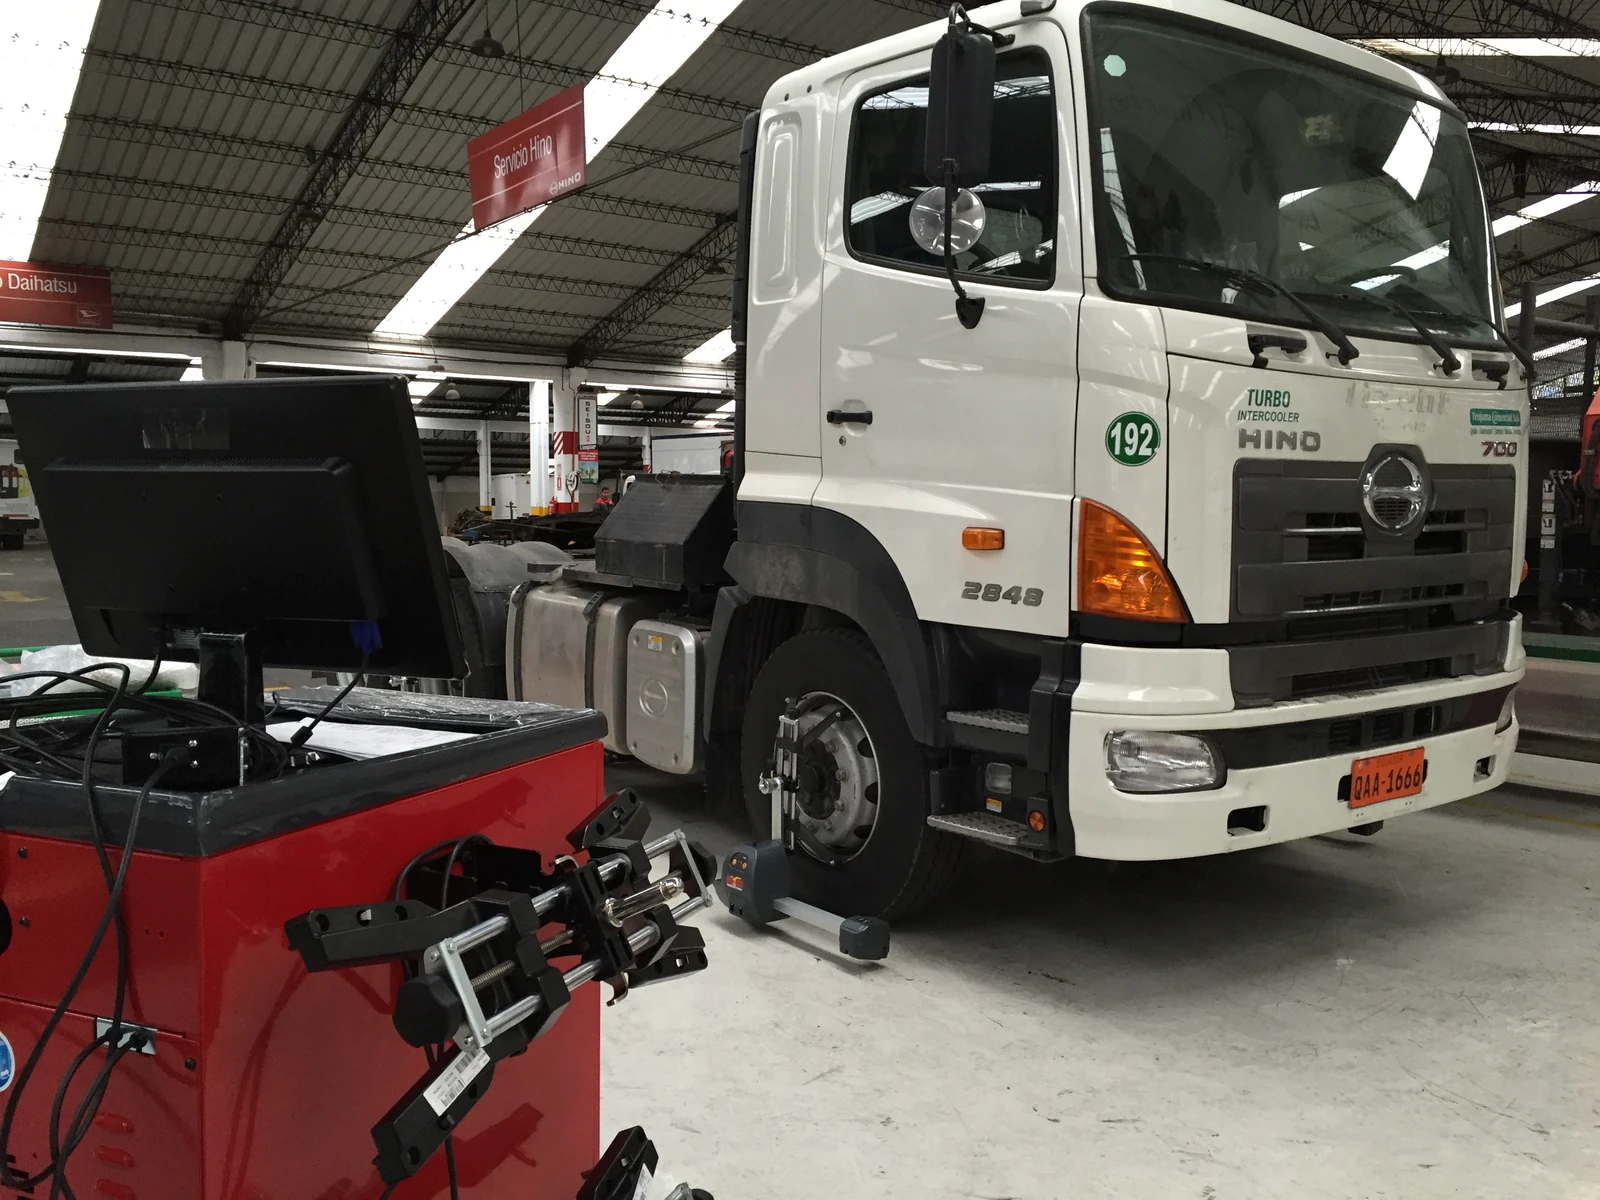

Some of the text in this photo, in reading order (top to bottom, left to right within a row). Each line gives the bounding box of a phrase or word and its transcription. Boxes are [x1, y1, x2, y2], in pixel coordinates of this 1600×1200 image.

[494, 135, 552, 178] Servicio Hino
[558, 172, 581, 190] HINO
[8, 273, 77, 293] Daihatsu
[1246, 388, 1291, 409] TURBO
[1237, 409, 1300, 424] INTERCOOLER
[1110, 421, 1154, 457] 192
[1238, 428, 1321, 453] HINO
[1481, 440, 1518, 458] 700
[961, 580, 1044, 607] 2848
